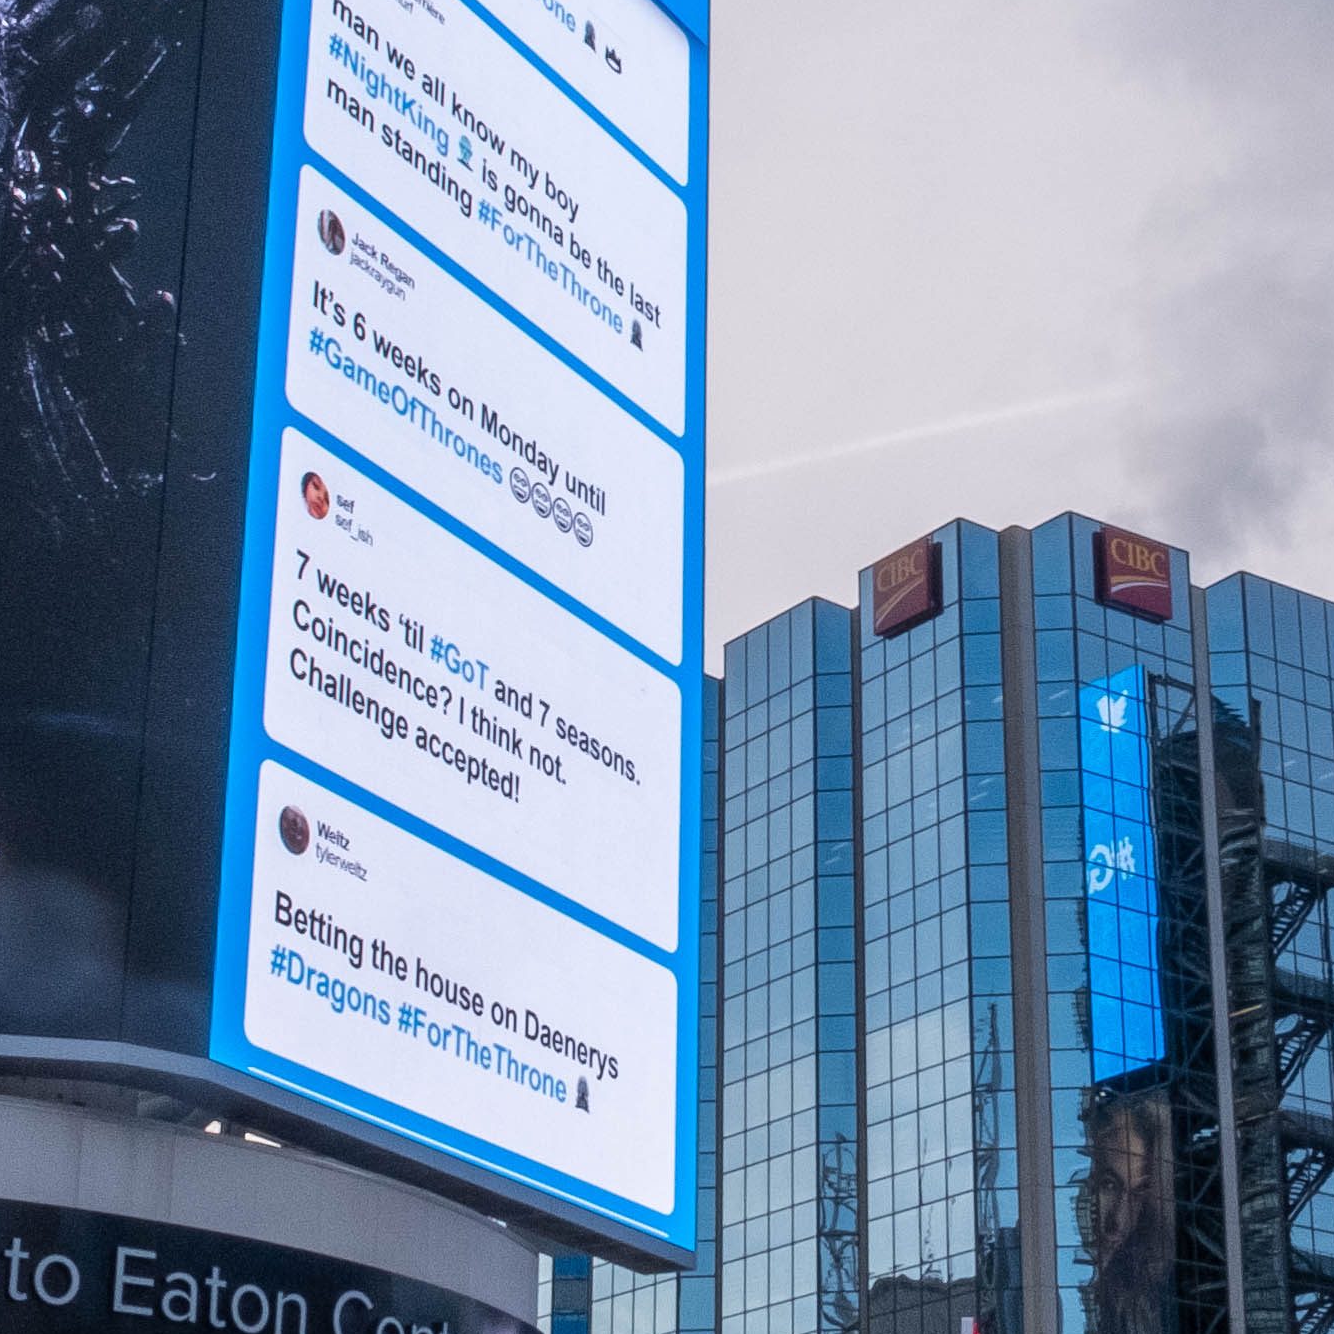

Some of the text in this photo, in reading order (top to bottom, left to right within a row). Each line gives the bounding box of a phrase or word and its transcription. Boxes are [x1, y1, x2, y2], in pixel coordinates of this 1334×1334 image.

[327, 77, 624, 334] man standing #ForTheThrone
[328, 32, 662, 329] #NightKing is gonna be the last
[386, 40, 416, 81] we
[421, 72, 446, 108] all
[452, 91, 506, 157] know
[510, 147, 541, 191] my
[545, 171, 580, 224] boy
[309, 325, 504, 486] #GameOfThrones
[353, 311, 367, 342] 6
[373, 328, 442, 398] weeks
[447, 384, 475, 421] on
[480, 402, 560, 487] Monday
[565, 469, 607, 517] until
[875, 545, 924, 594] CIBC
[1109, 537, 1167, 576] CIBC
[290, 647, 520, 804] Challenge accepted!
[292, 599, 568, 786] Coincidence? I think not.
[296, 548, 311, 581] 7
[317, 568, 392, 633] weeks
[430, 634, 491, 691] #GoT
[494, 677, 533, 719] and
[538, 699, 551, 728] 7
[555, 715, 642, 786] seasons.
[270, 943, 568, 1104] #Dragons #ForTheThrone
[274, 889, 620, 1083] Betting the house on Daenerys
